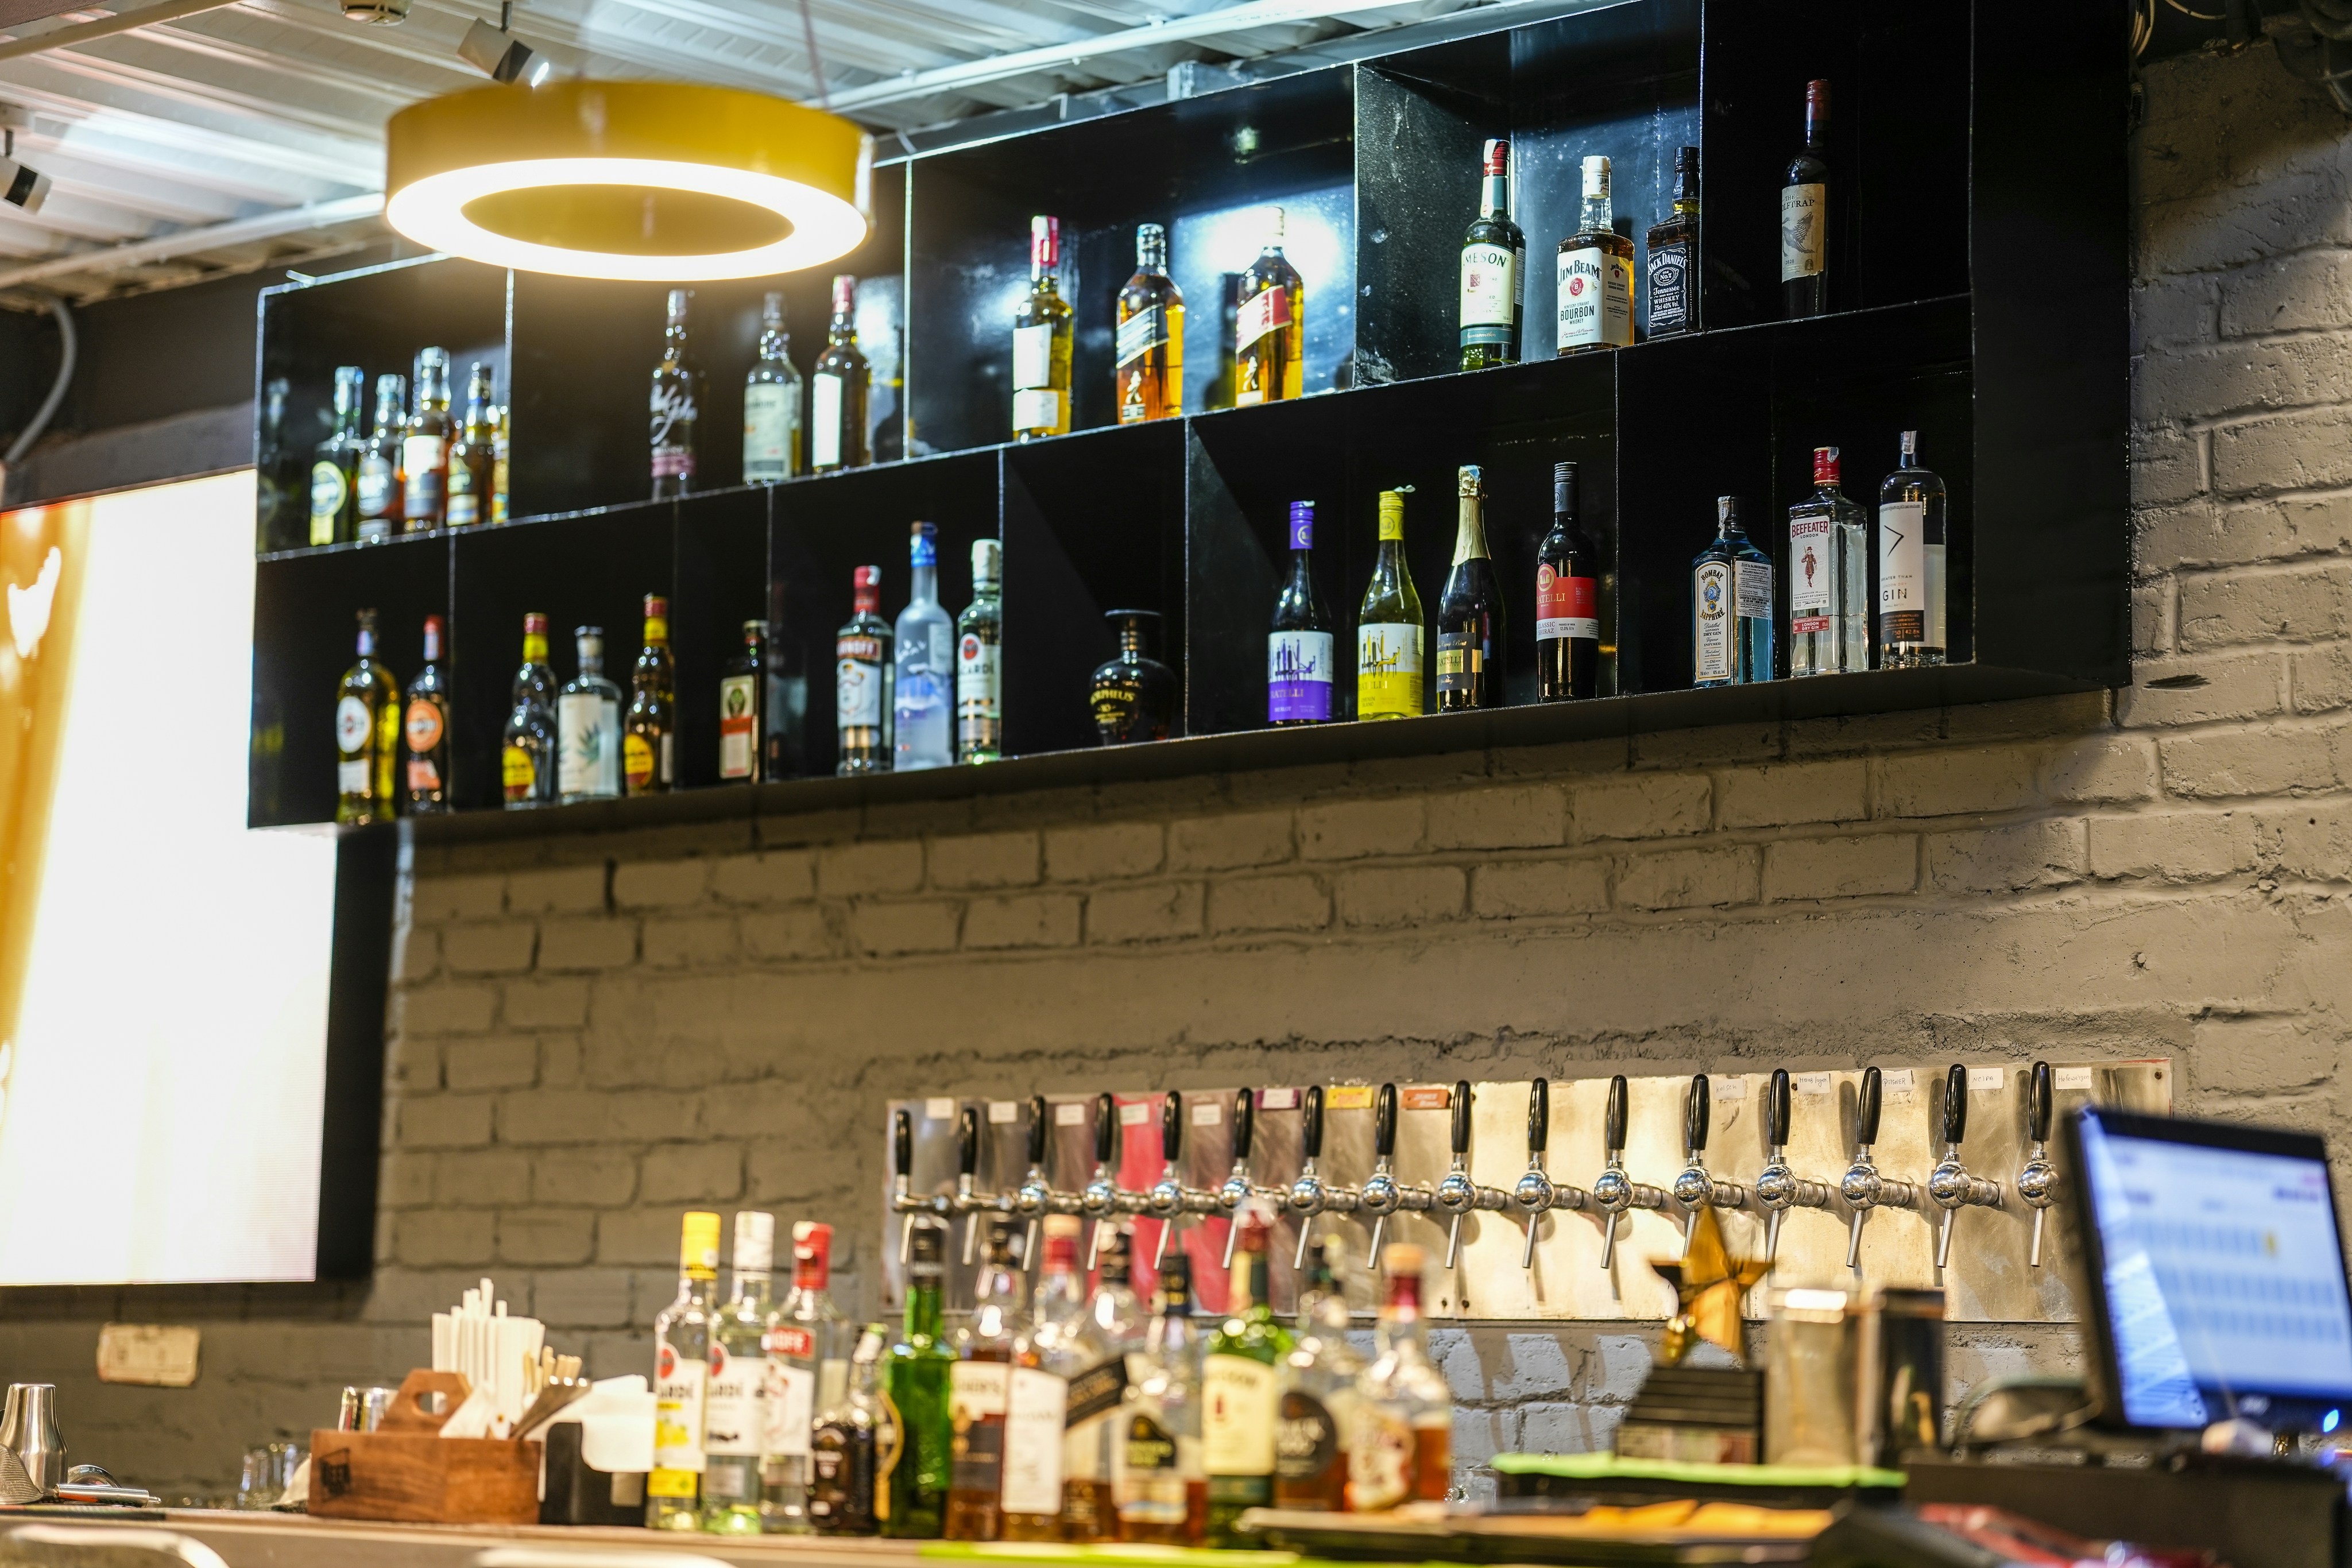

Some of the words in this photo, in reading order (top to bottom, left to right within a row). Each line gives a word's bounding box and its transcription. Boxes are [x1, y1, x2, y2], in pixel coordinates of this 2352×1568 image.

[1463, 253, 1507, 268] MESON
[1647, 257, 1662, 275] JACK
[1662, 253, 1688, 269] DANIEL'S
[1558, 265, 1572, 286] JIM
[1574, 260, 1600, 281] BEAM
[1653, 285, 1680, 296] Tennessee
[1654, 295, 1680, 305] WHISKEY
[1560, 305, 1595, 321] BOURBON
[1792, 521, 1828, 539] BEEFEATER
[1700, 570, 1724, 581] BOMBAY
[1883, 588, 1907, 601] GIN
[1700, 610, 1726, 621] SAPPHIRE
[1270, 688, 1304, 699] RATELLI
